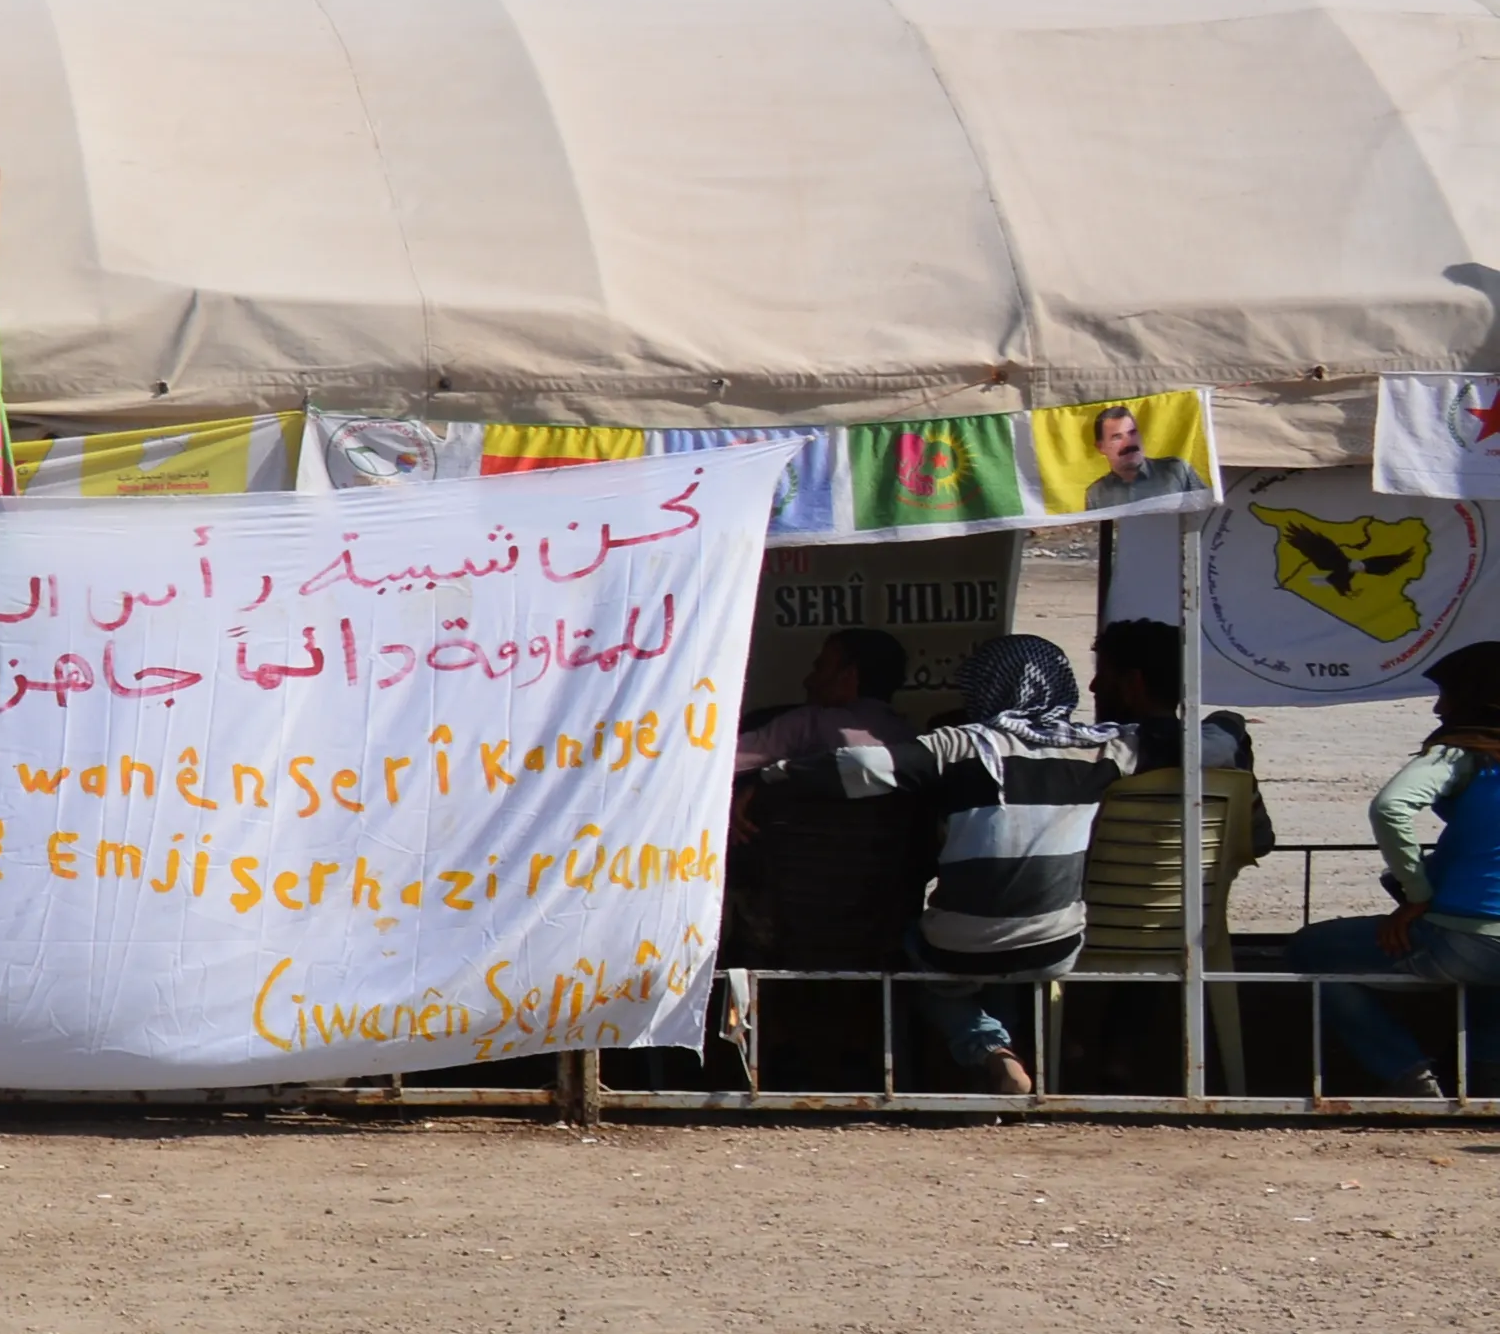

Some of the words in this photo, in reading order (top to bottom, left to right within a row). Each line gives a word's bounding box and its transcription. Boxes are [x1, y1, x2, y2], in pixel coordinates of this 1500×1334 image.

[538, 467, 705, 583] نحن
[774, 572, 866, 628] SERÎ
[885, 580, 998, 626] HILDE
